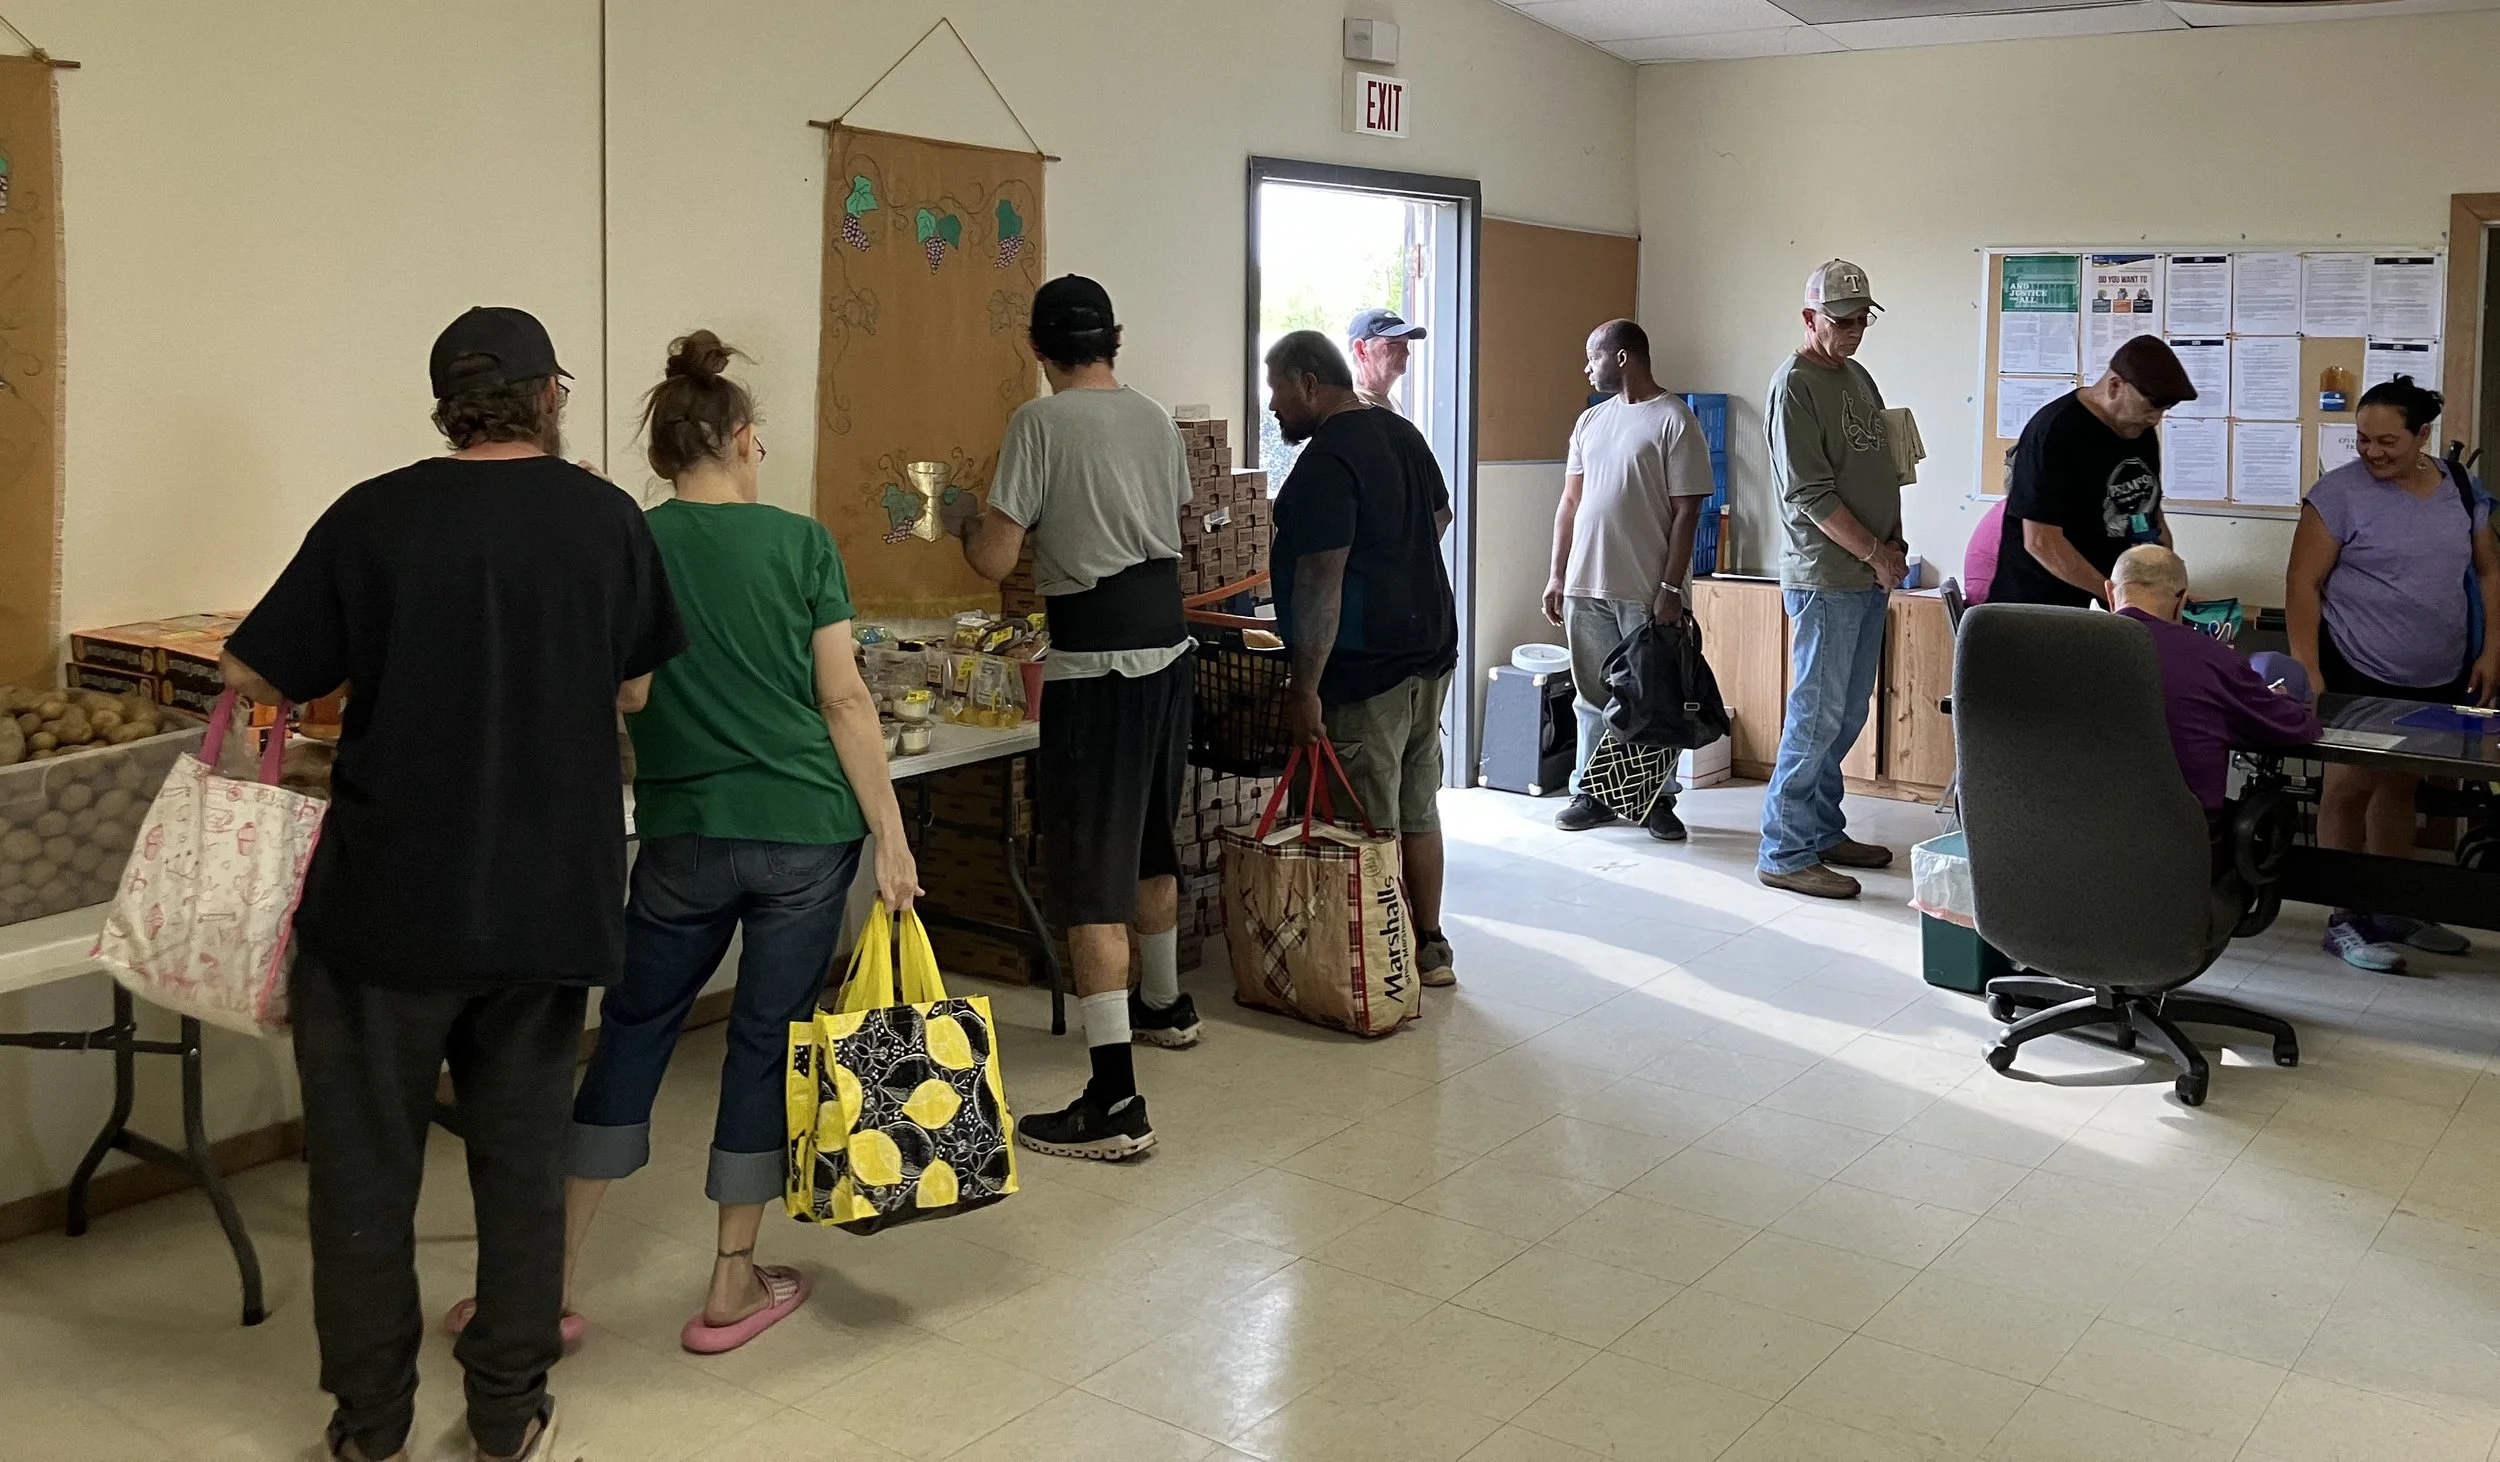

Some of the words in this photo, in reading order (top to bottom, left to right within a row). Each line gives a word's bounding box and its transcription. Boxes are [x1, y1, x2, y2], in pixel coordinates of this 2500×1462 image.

[1367, 80, 1402, 132] EXIT
[1843, 275, 1860, 292] T
[2108, 275, 2120, 284] YOU
[2121, 275, 2139, 284] WANT
[2139, 275, 2148, 284] TO
[2010, 282, 2030, 290] AND
[2009, 289, 2048, 297] JUSTICE
[2019, 296, 2037, 304] ALL
[1376, 875, 1404, 1003] Marshalls
